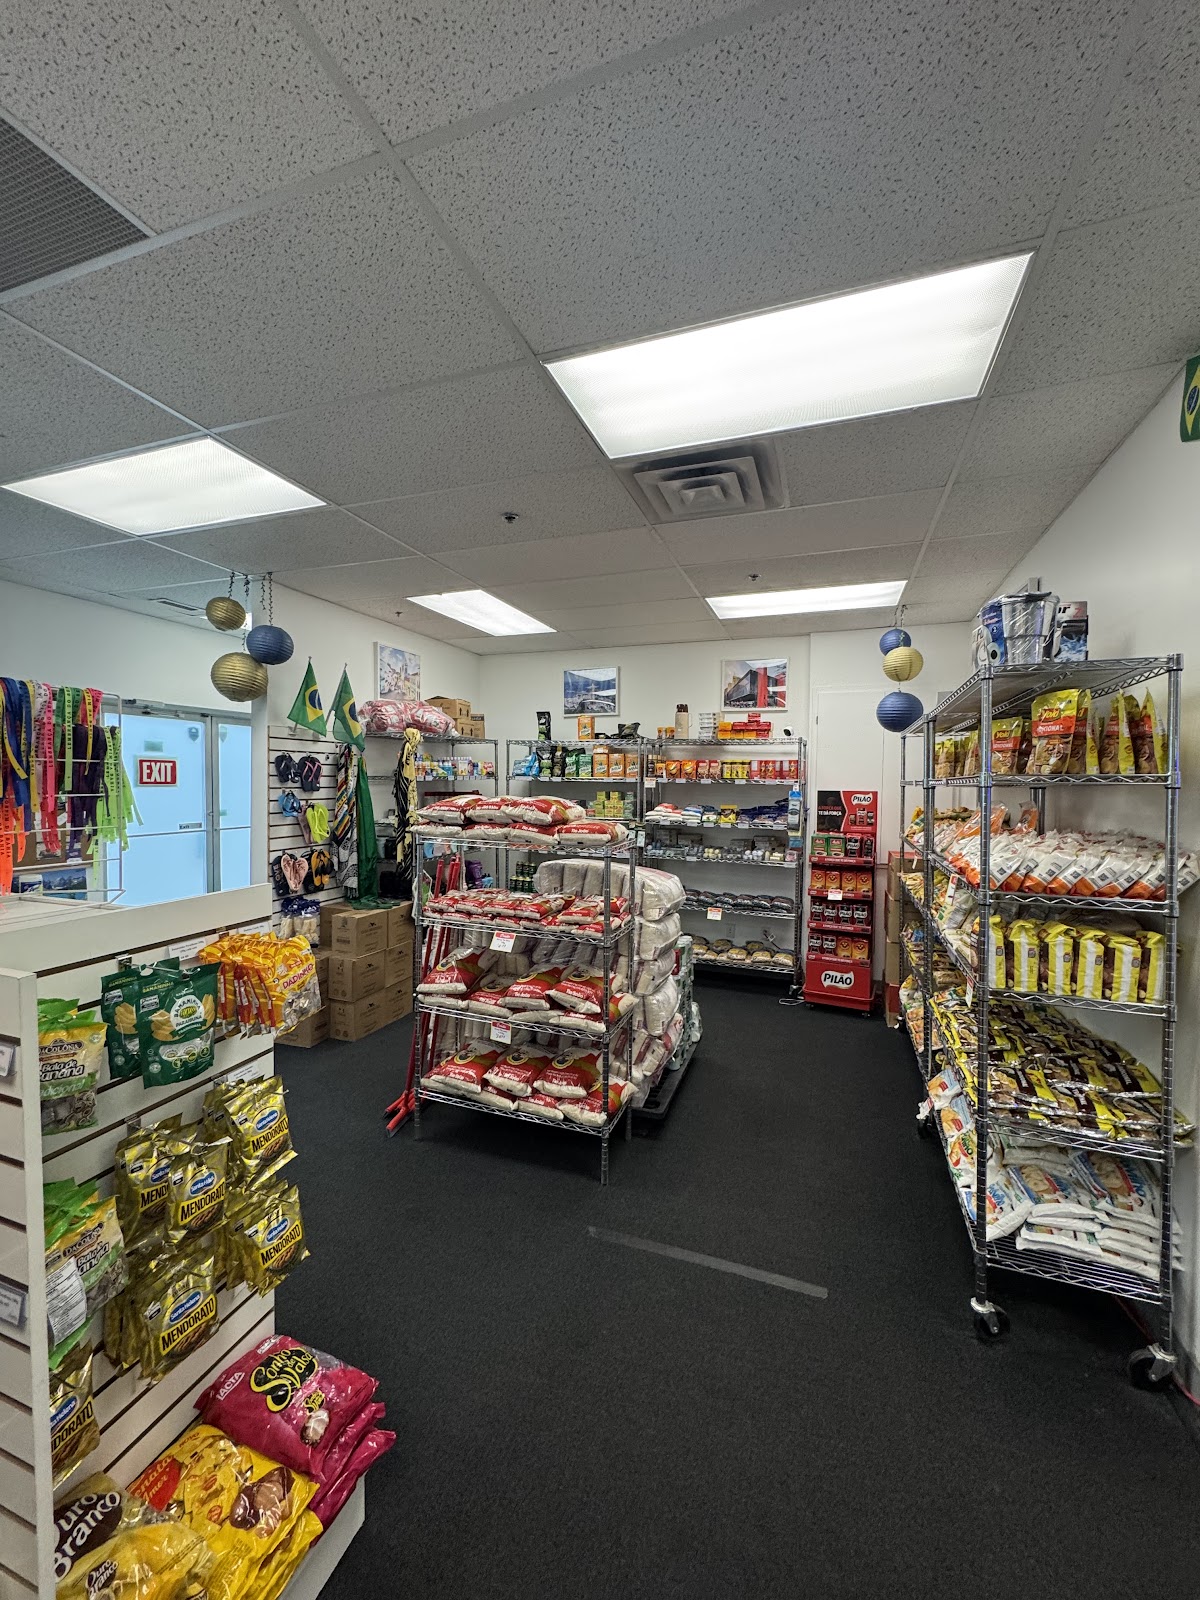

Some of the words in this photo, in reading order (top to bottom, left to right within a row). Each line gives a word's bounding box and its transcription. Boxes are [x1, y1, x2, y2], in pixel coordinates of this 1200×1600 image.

[142, 761, 173, 783] EXIT
[852, 795, 872, 803] PILÃO
[282, 963, 314, 989] DADINHO
[823, 973, 852, 985] PILÃO
[40, 1042, 80, 1055] ACOLÔNIA
[40, 1065, 84, 1082] anana
[42, 1061, 62, 1074] Bala
[66, 1058, 77, 1069] de
[40, 1079, 85, 1097] adicional
[251, 1117, 289, 1153] MENDORATO
[260, 1224, 301, 1266] MENDORATO
[161, 1297, 214, 1351] MENDORATO
[250, 1349, 291, 1412] Sonho
[279, 1352, 313, 1389] Valsa
[216, 1371, 245, 1401] LACTA
[52, 1400, 93, 1452] DORATO
[134, 1455, 173, 1498] enata
[55, 1491, 121, 1583] Branco
[86, 1559, 112, 1588] Ouro
